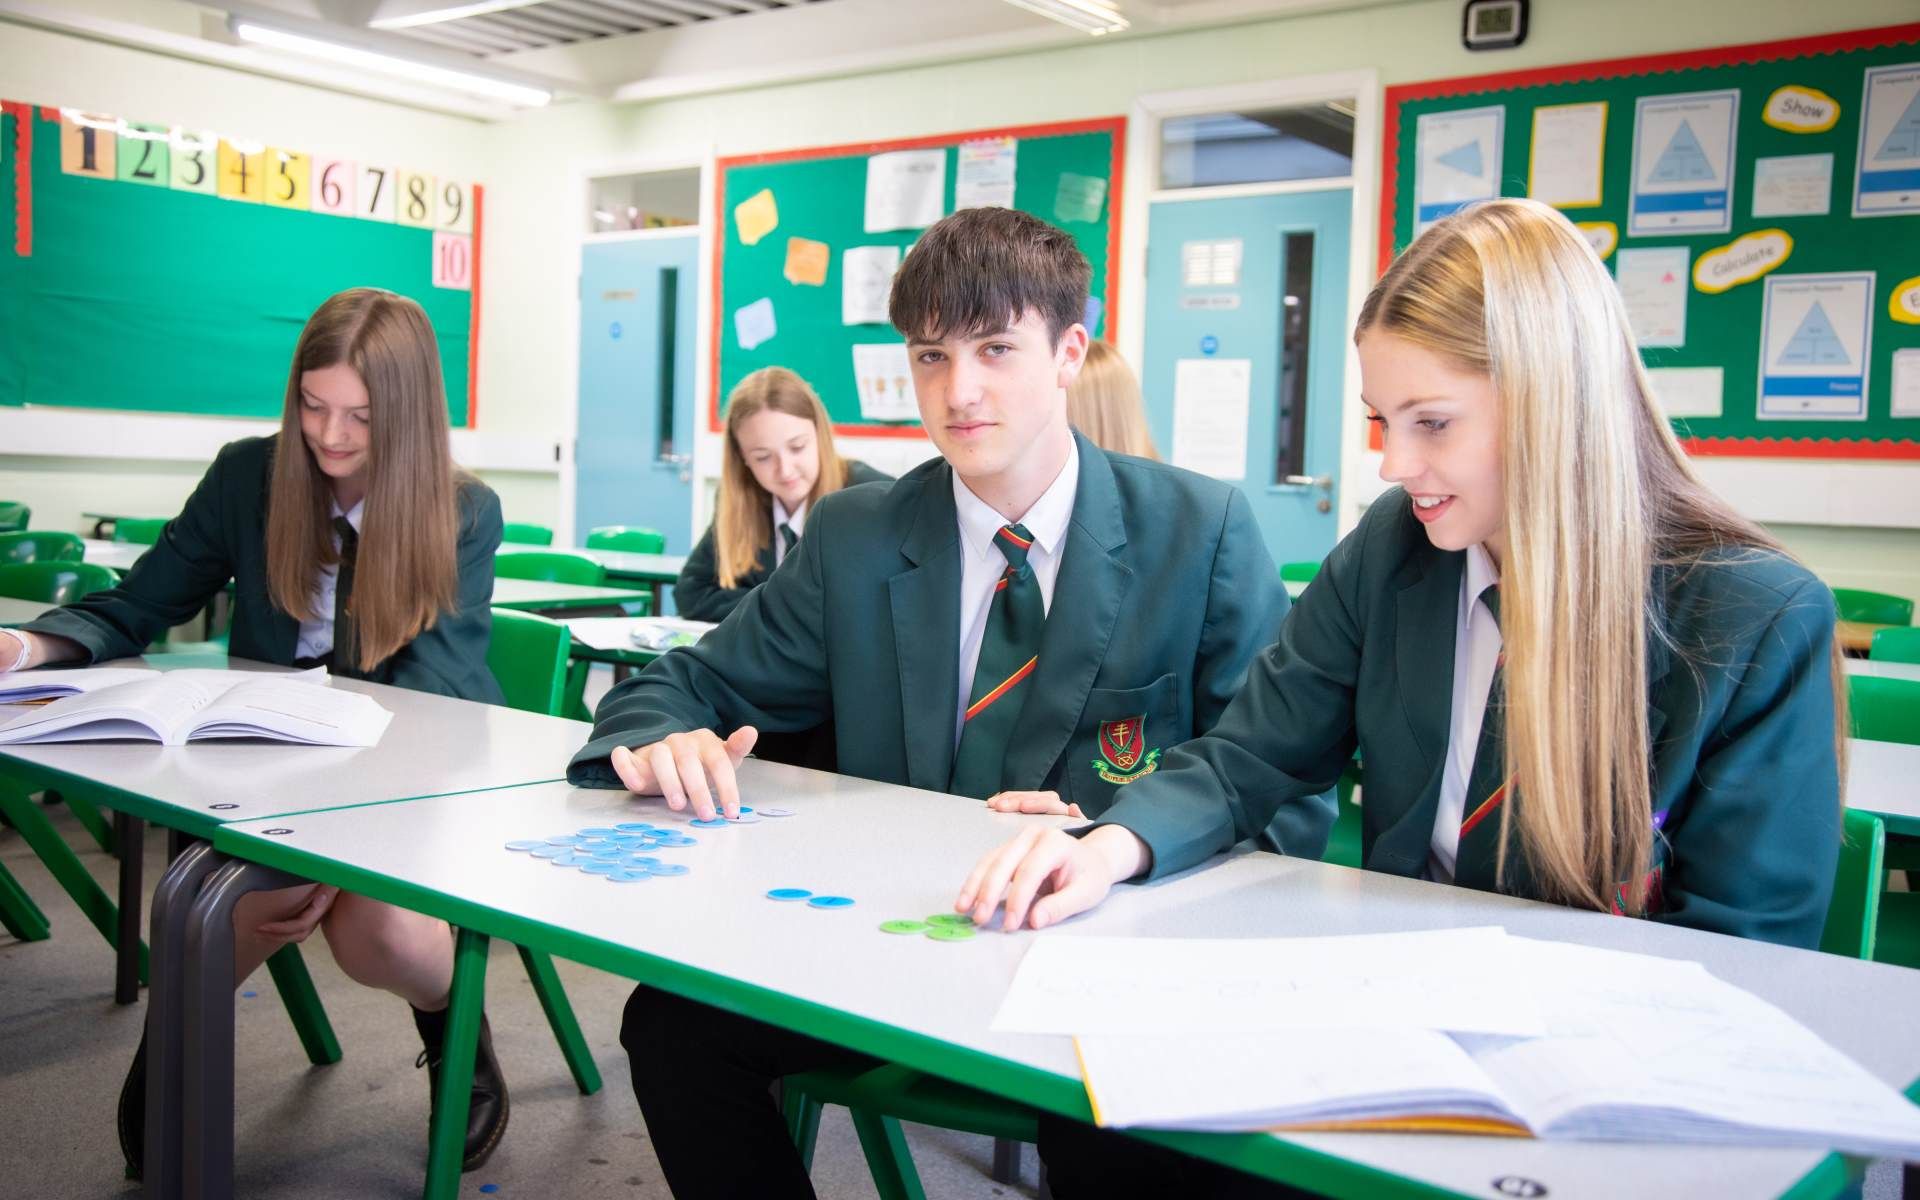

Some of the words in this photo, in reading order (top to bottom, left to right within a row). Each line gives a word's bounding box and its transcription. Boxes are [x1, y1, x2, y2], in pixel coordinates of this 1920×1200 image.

[1781, 97, 1825, 118] Show
[77, 126, 99, 171] 1
[131, 127, 156, 179] 2
[180, 133, 205, 185] 3
[278, 154, 299, 201] 5
[321, 162, 342, 208] 6
[367, 167, 385, 213] 7
[408, 174, 426, 221] 8
[444, 182, 462, 226] 9
[440, 239, 466, 283] 10
[1712, 245, 1775, 276] Calculate
